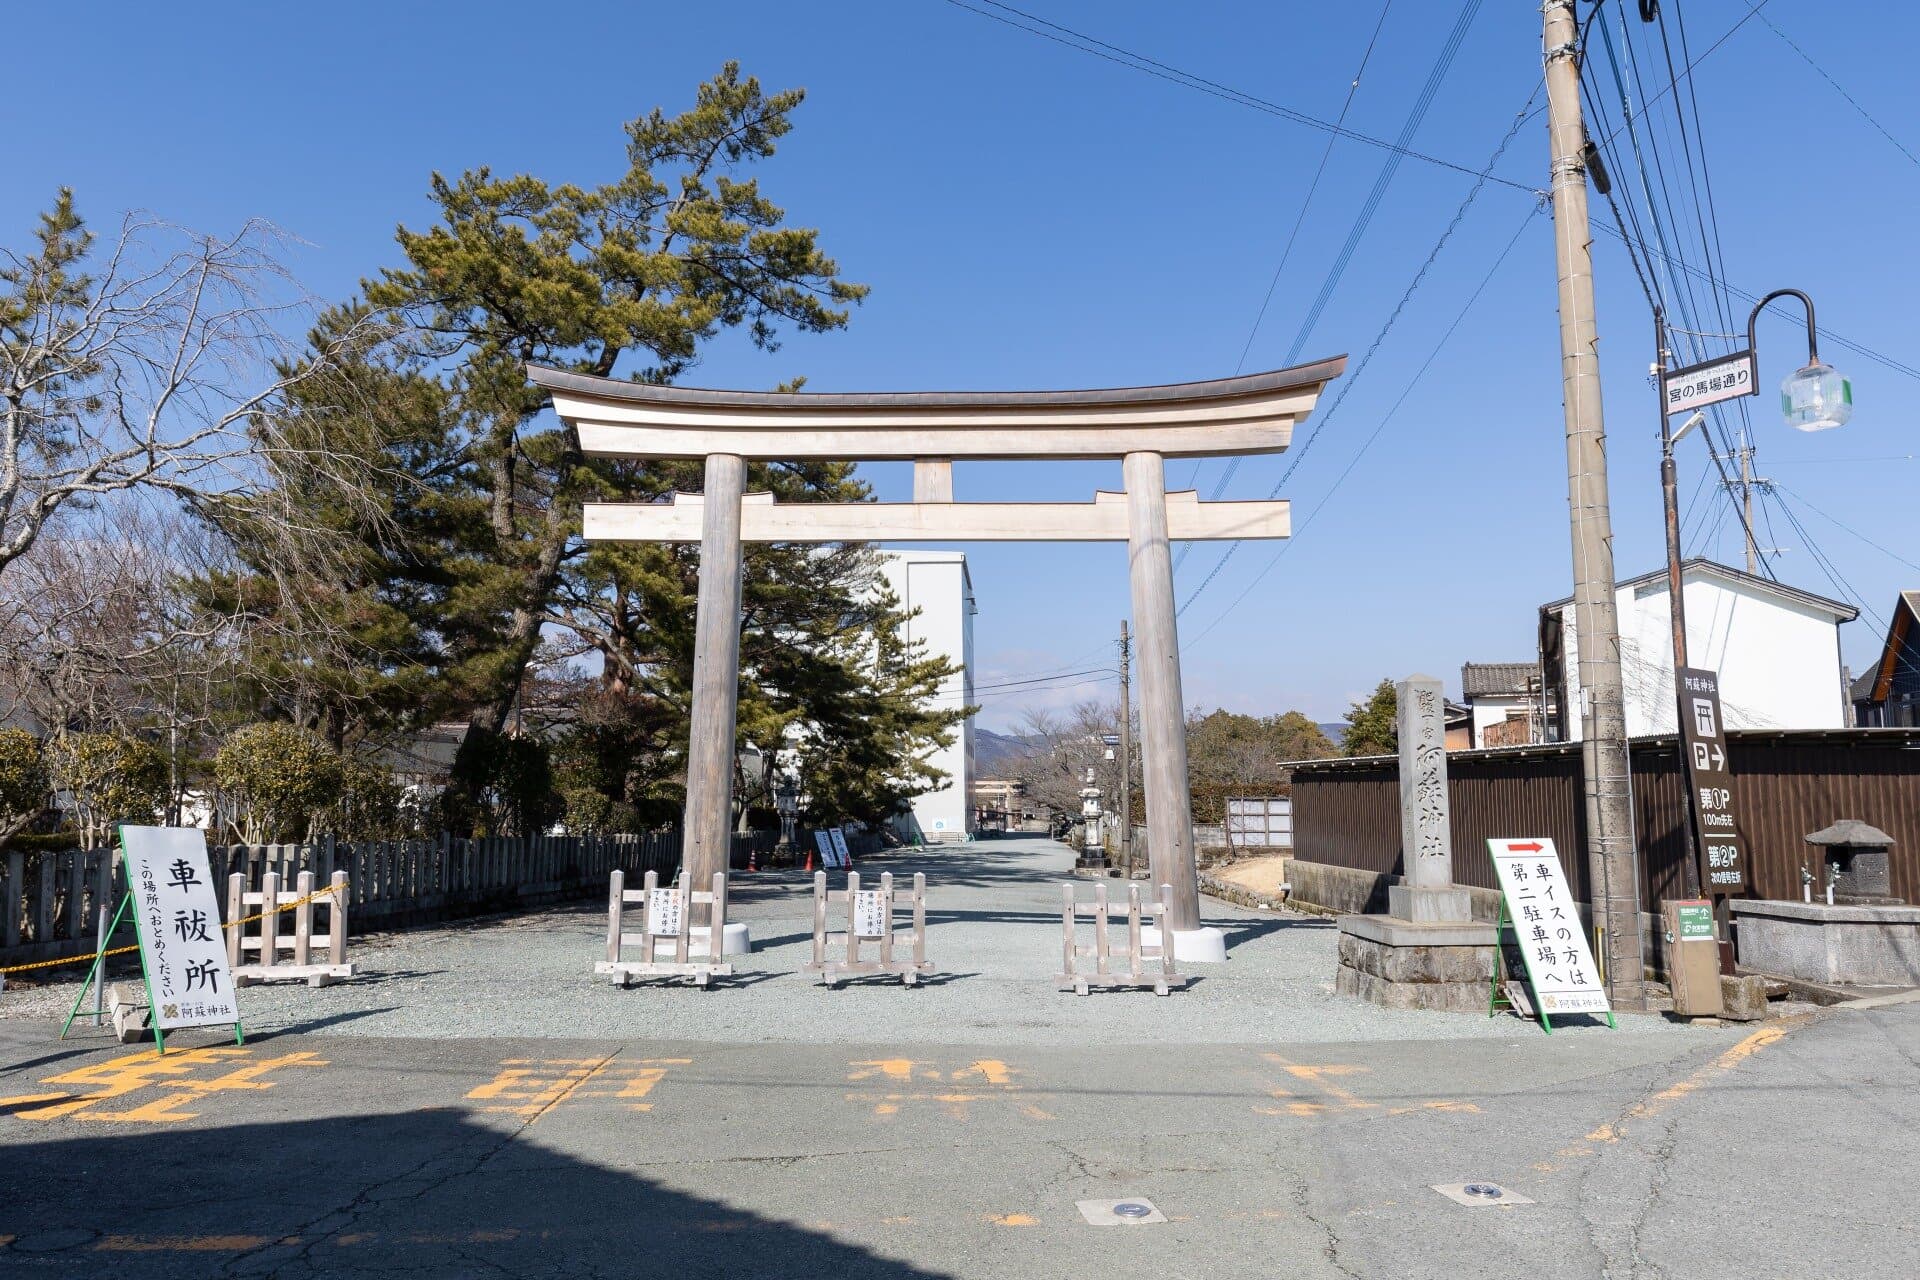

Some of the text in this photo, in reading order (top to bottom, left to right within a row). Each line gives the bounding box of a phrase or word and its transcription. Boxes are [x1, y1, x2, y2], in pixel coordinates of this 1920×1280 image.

[1669, 370, 1748, 403] 宮の馬場通り
[1684, 677, 1716, 693] 阿蘇神社
[1696, 746, 1705, 767] P
[141, 859, 174, 997] この場所へおとめください
[167, 858, 220, 994] 車祓所
[1511, 863, 1563, 983] 第二駐車場へ
[1536, 863, 1588, 985] 車イスの方は
[181, 1005, 231, 1019] 阿蘇神社
